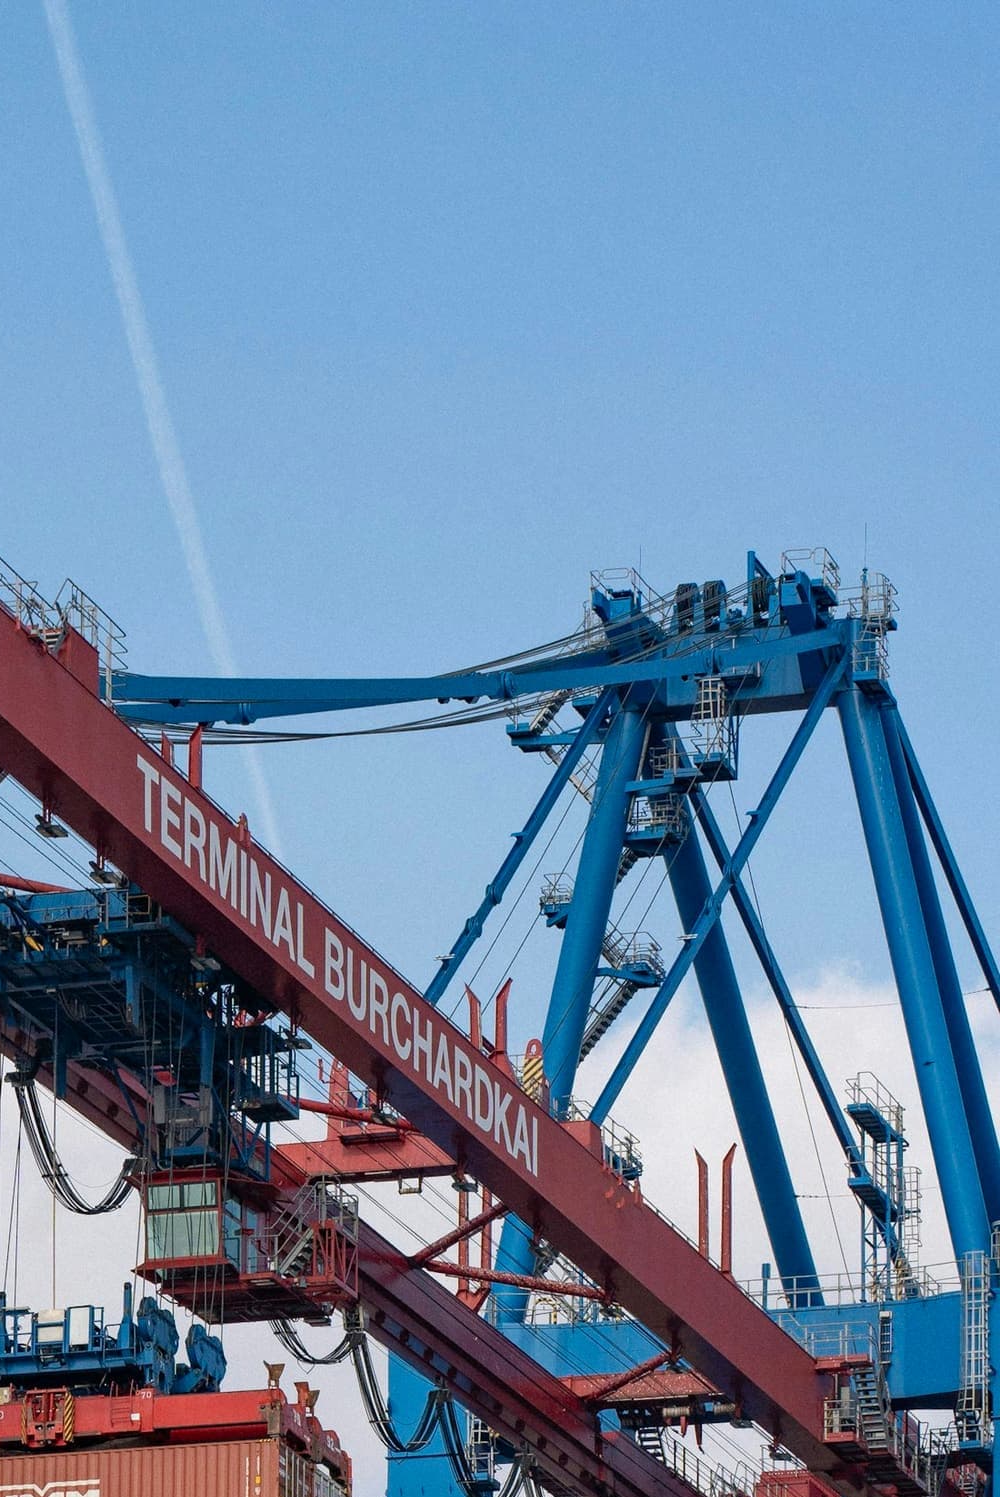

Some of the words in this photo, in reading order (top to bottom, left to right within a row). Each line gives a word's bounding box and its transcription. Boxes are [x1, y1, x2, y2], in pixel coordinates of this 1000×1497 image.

[137, 754, 315, 979] TERMINAL
[324, 927, 539, 1177] BURCHARDKAI
[141, 1391, 152, 1399] 70
